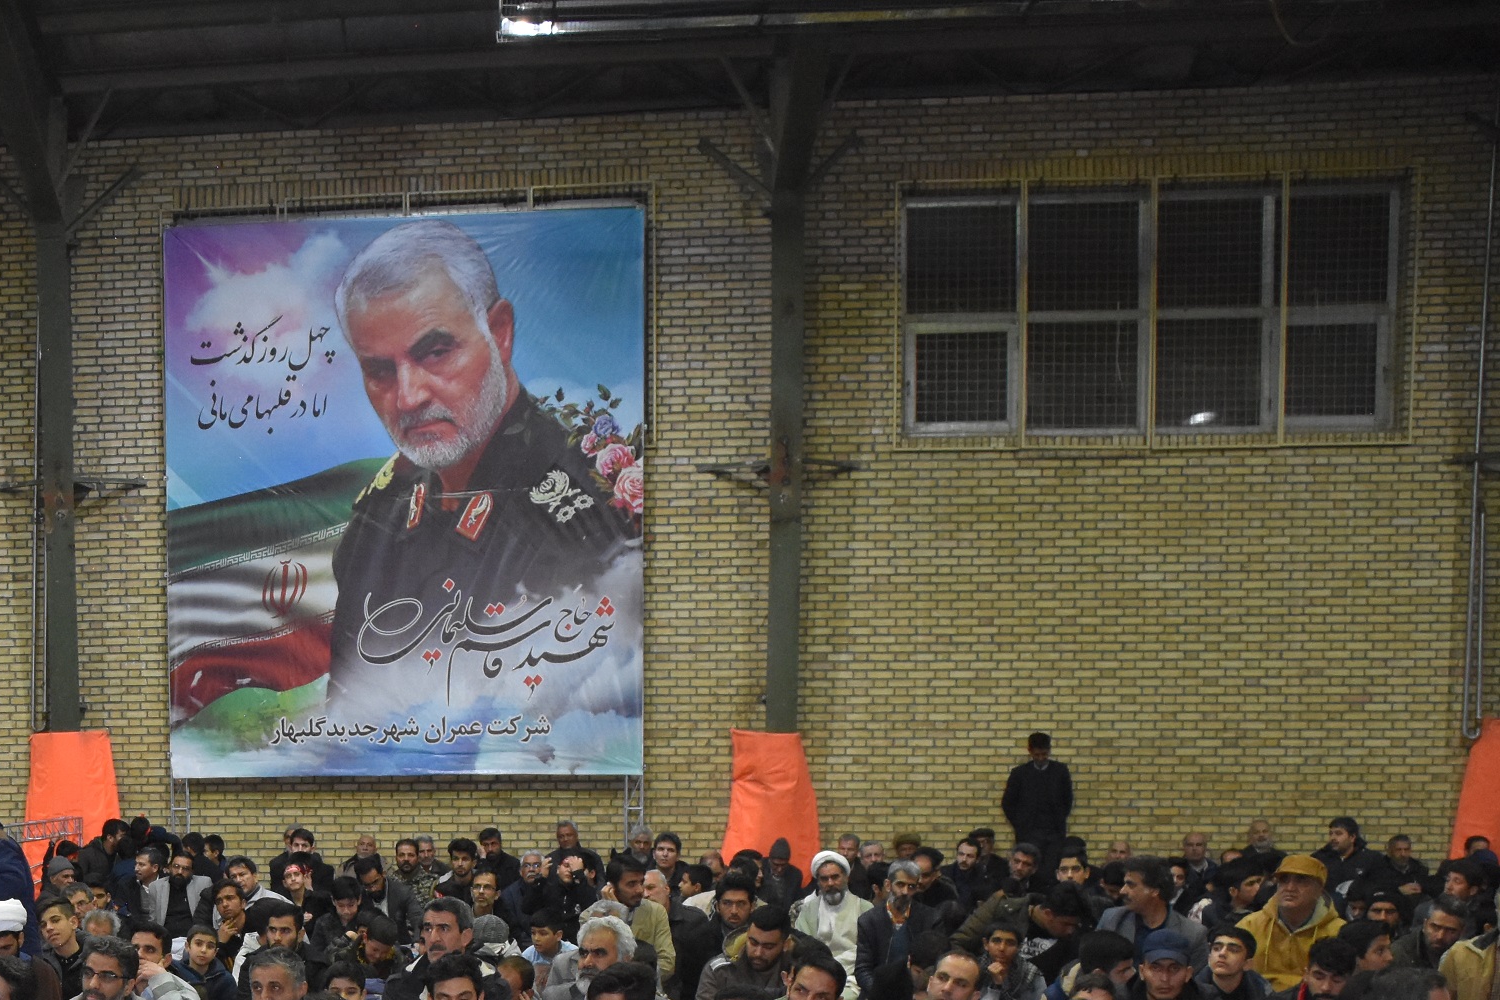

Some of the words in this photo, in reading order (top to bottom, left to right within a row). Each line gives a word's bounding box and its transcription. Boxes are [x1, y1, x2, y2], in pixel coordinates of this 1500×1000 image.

[190, 314, 284, 365] گذشت
[257, 335, 288, 363] روز
[288, 326, 336, 371] چهل
[197, 379, 228, 430] مانی
[228, 394, 254, 429] می
[255, 374, 297, 435] قلبها
[289, 399, 307, 418] در
[312, 392, 328, 418] اما
[357, 577, 554, 666] سلیمانی
[445, 602, 553, 707] قاسم
[512, 595, 616, 689] شهید
[270, 715, 327, 745] گلبهار
[326, 721, 378, 744] جدید
[377, 716, 420, 745] شهر
[424, 715, 483, 744] عمران
[486, 713, 551, 743] شرکت
